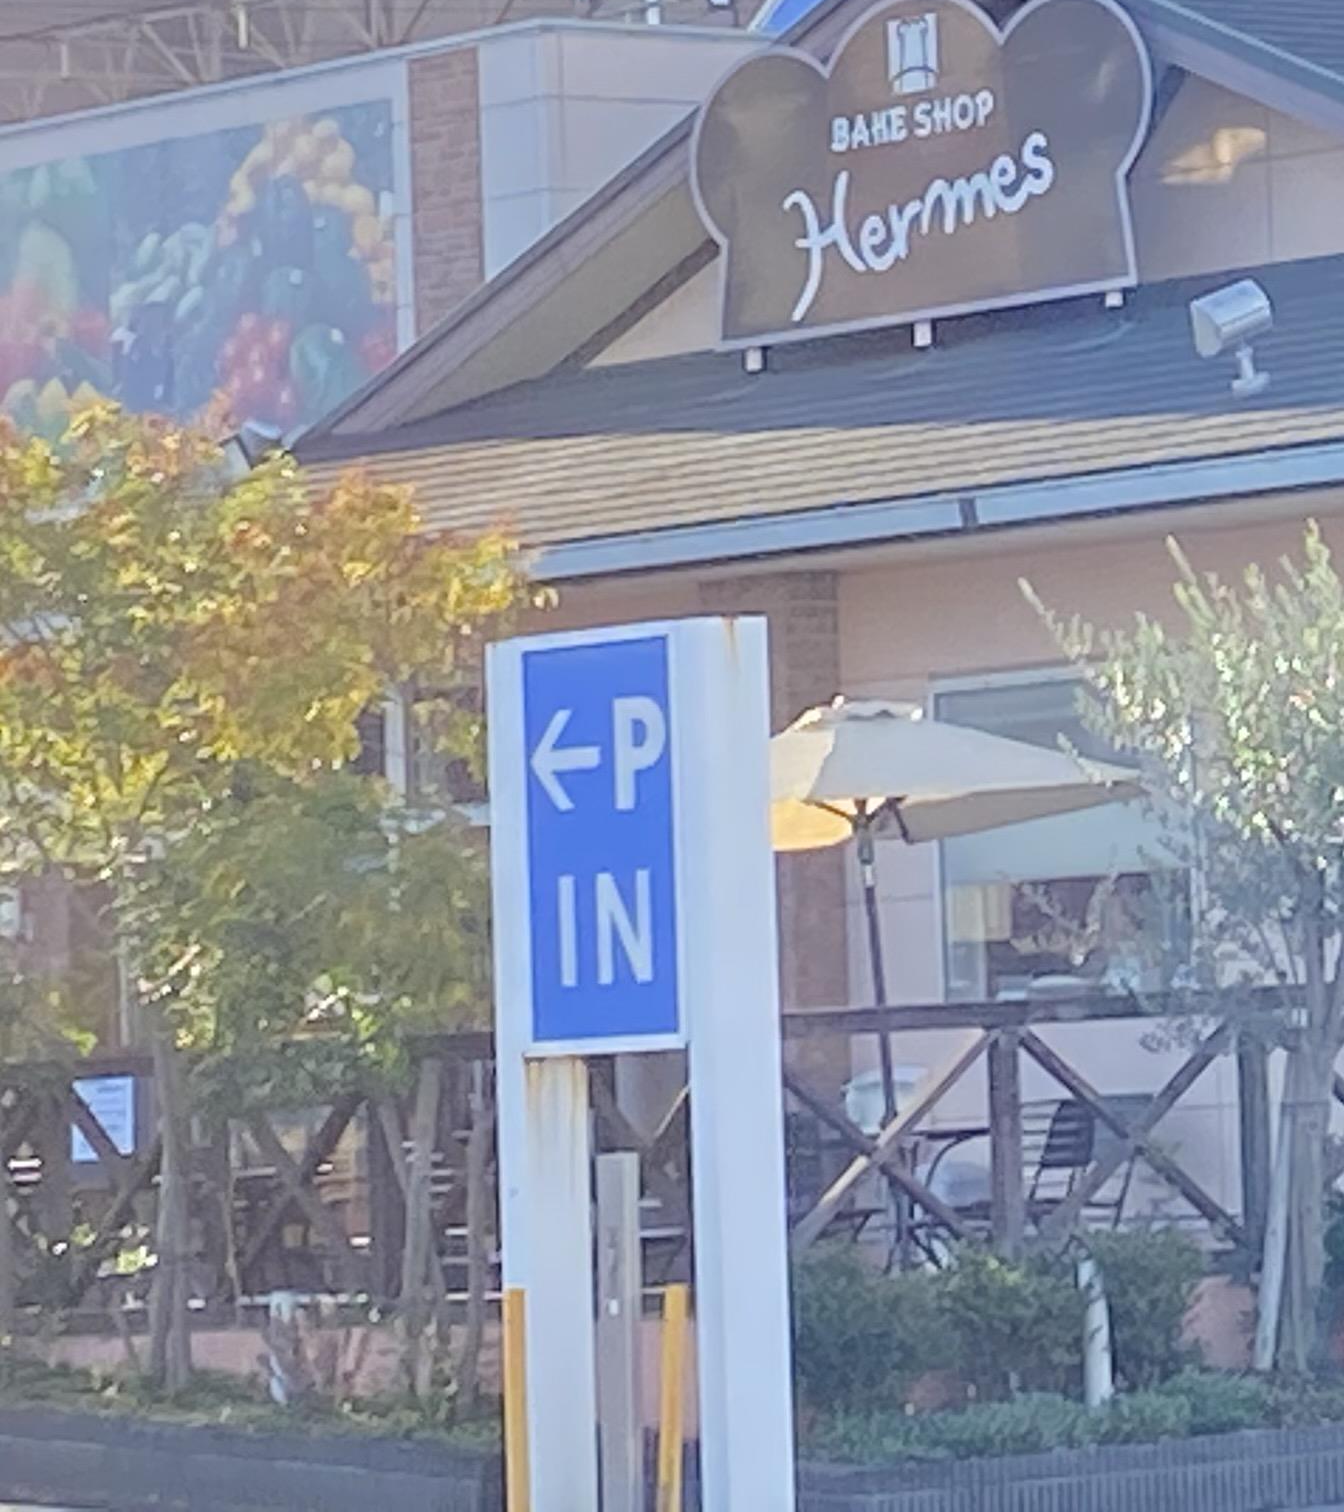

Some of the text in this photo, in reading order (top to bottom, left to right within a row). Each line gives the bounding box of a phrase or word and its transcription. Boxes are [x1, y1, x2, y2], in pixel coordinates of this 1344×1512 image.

[829, 89, 996, 153] BAKE SHOP
[782, 131, 1055, 323] Hermes
[612, 695, 667, 811] P
[556, 867, 654, 988] IN
